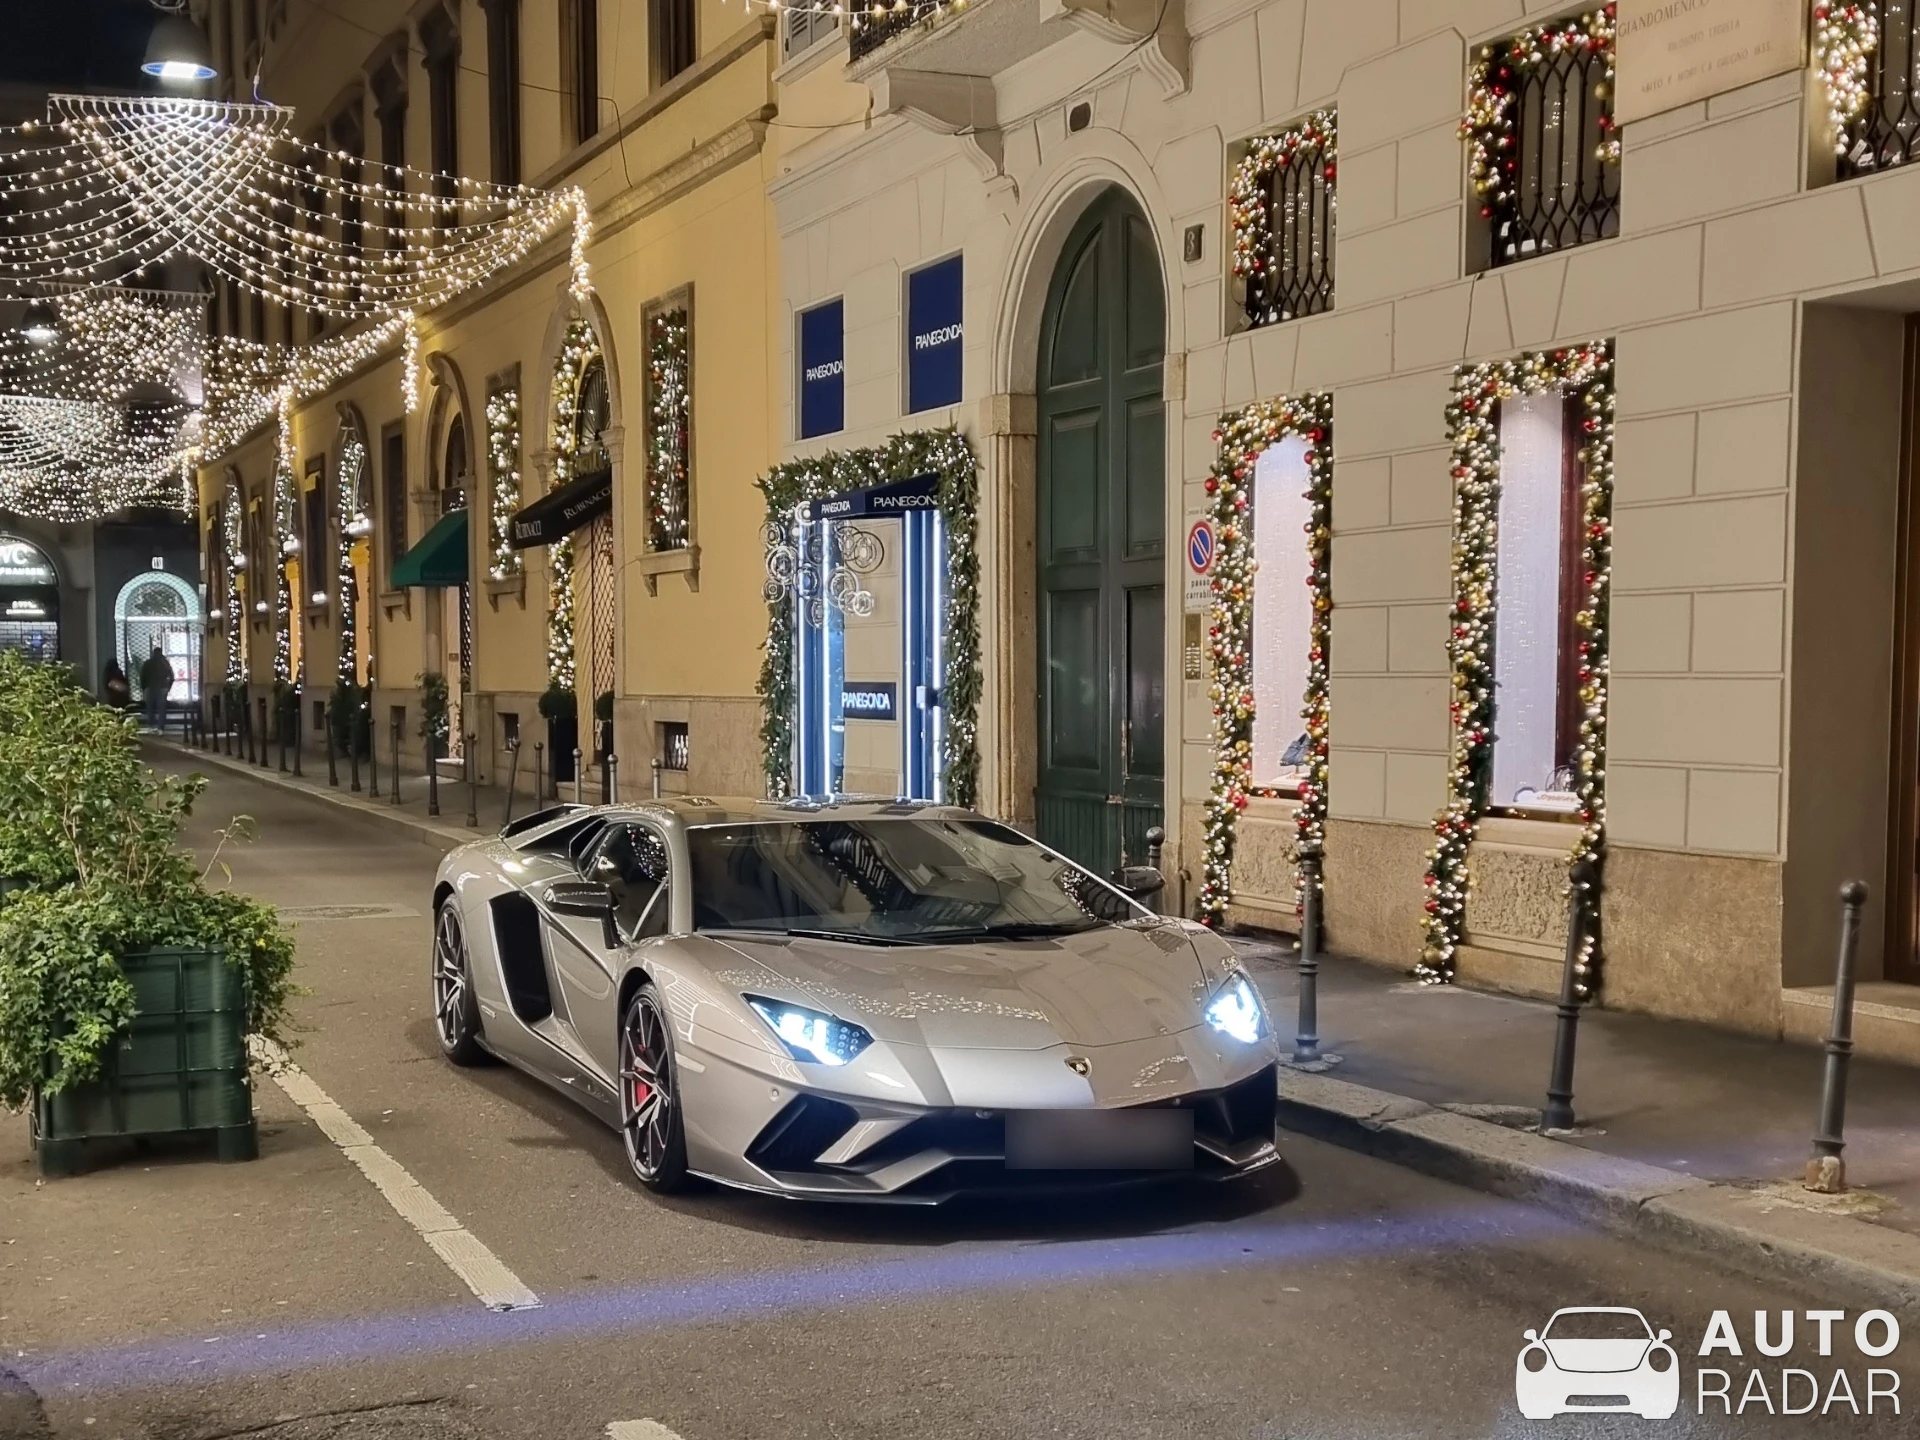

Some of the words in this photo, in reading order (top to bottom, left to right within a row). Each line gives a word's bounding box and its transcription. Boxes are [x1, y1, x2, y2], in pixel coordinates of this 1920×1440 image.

[915, 323, 963, 350] PIANEGONDA
[806, 360, 844, 382] PIANEGONDA
[821, 500, 851, 514] PIANEGONDA
[1191, 579, 1210, 588] passo
[842, 692, 890, 710] PIANEGONDA
